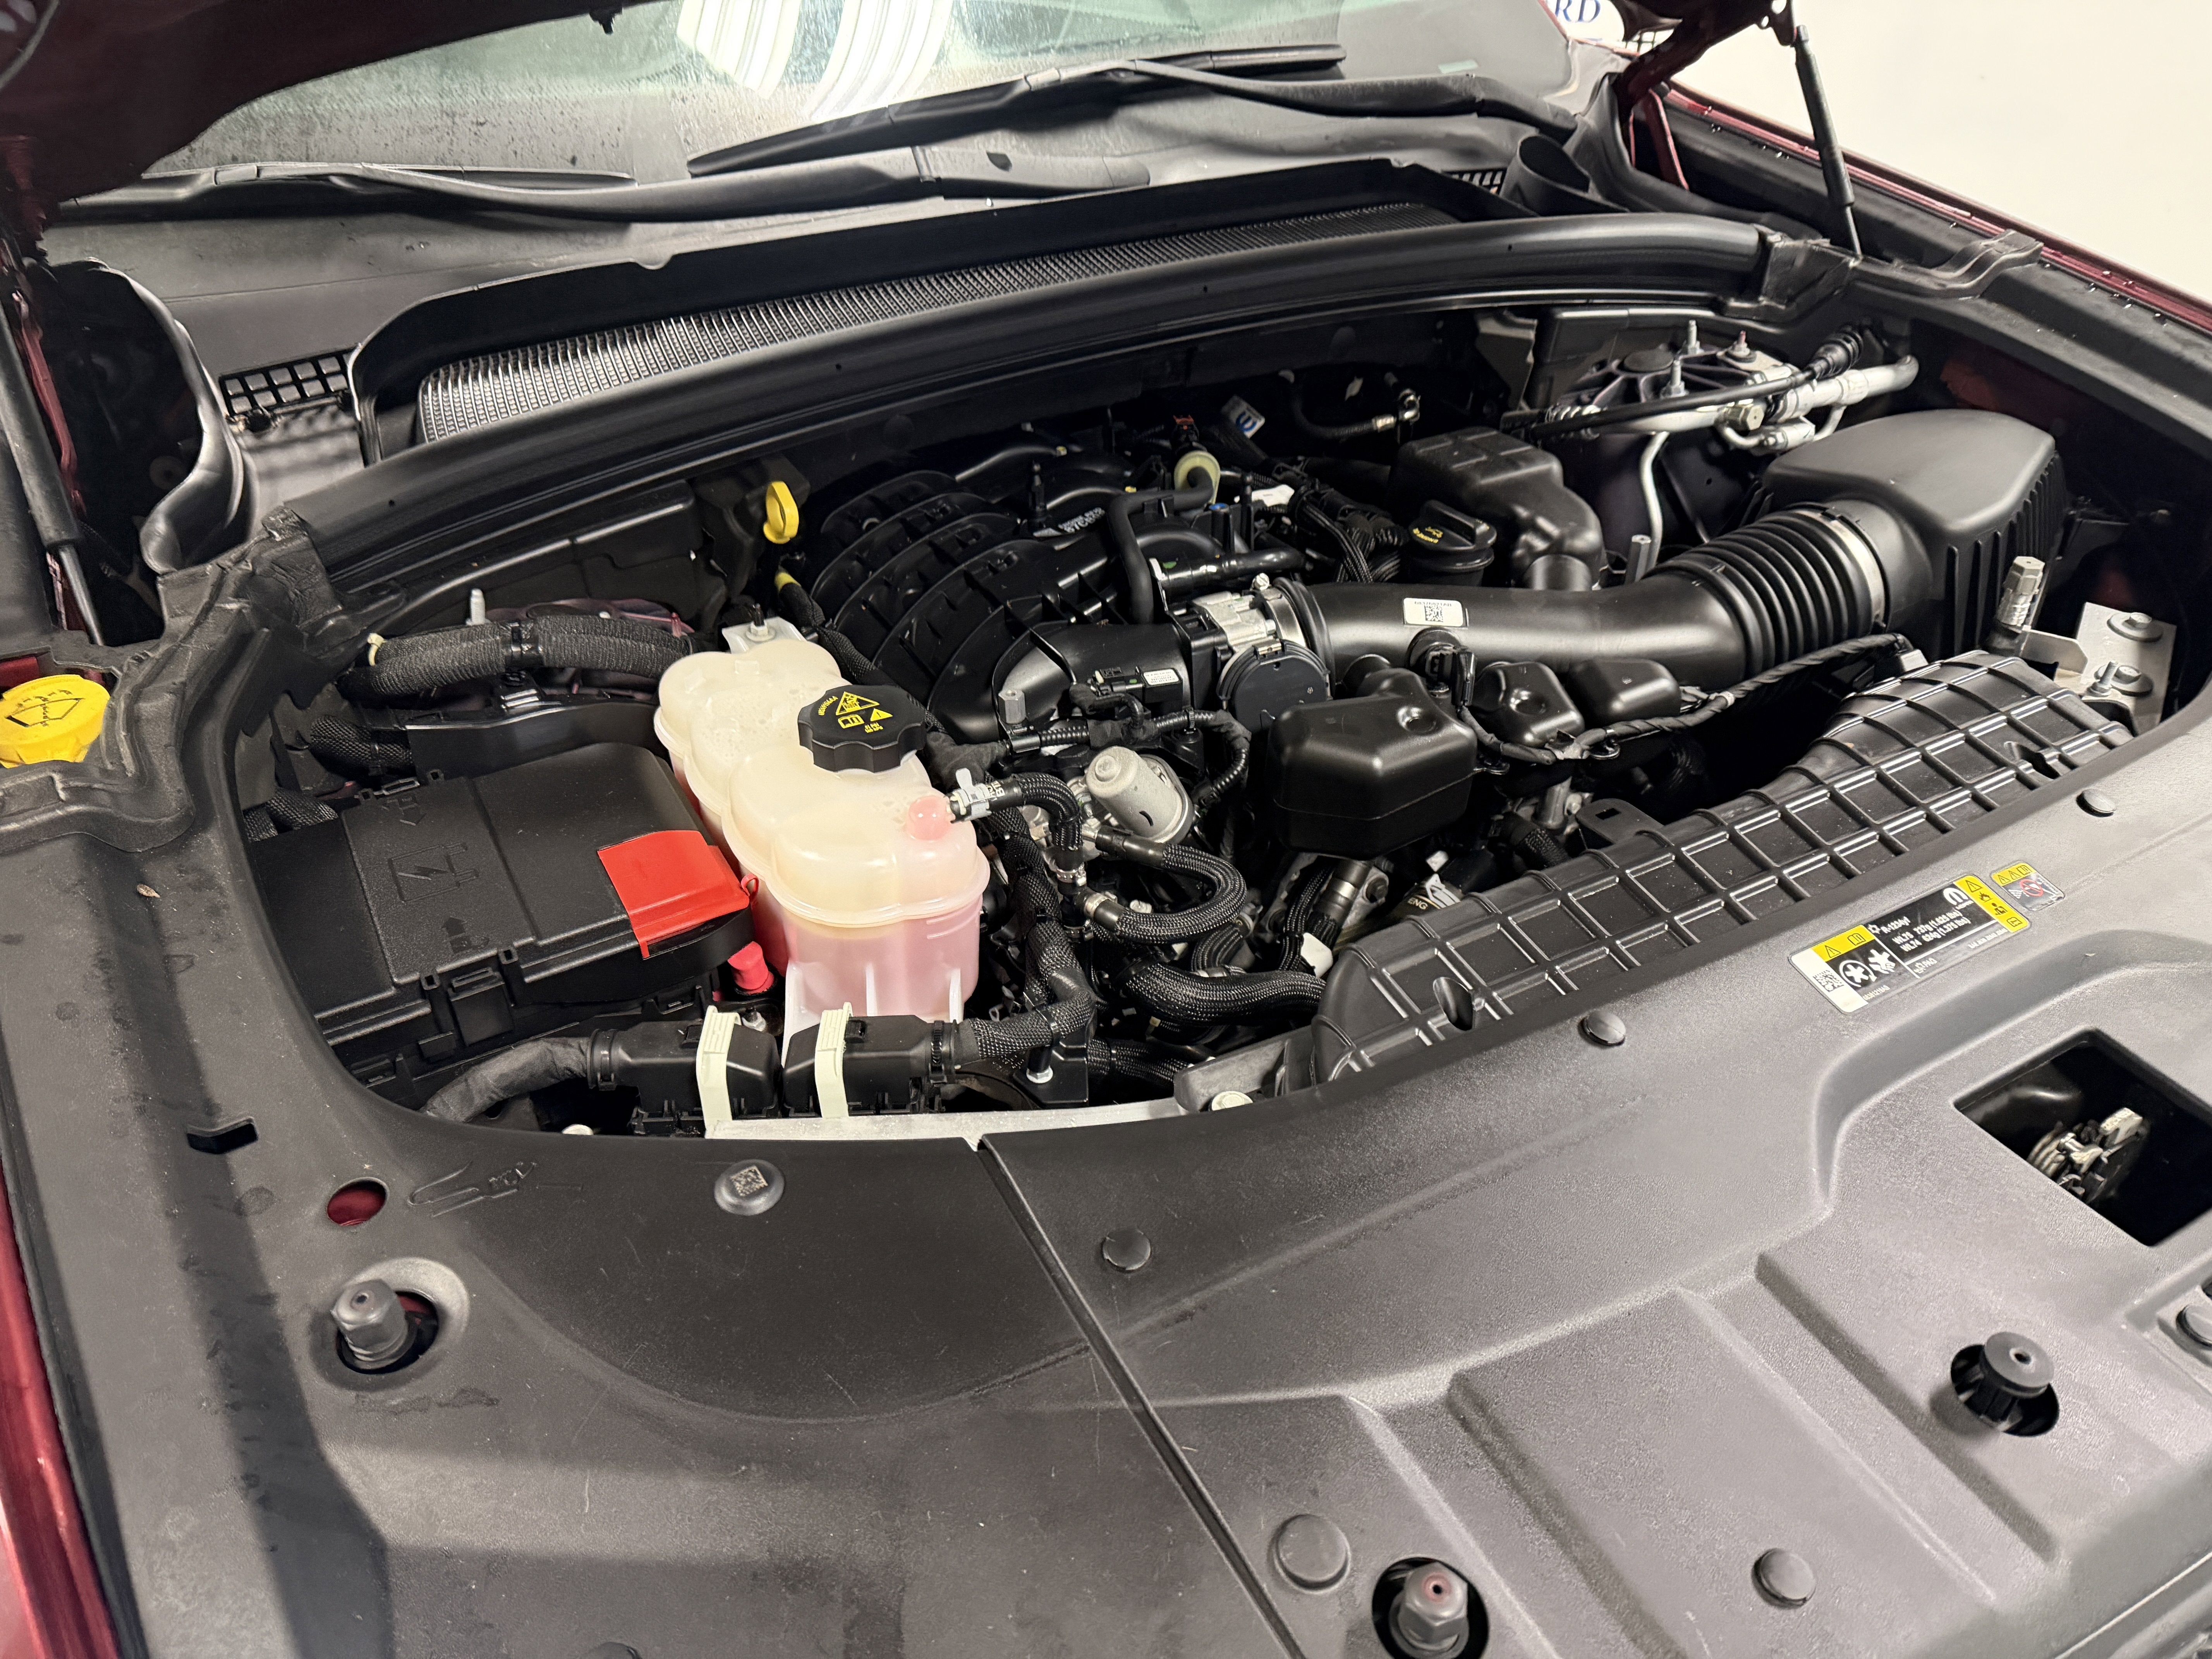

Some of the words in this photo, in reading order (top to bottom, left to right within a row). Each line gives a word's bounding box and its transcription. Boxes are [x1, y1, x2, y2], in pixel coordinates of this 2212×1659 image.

[1408, 897, 1428, 910] ENG
[1881, 916, 1911, 934] R-1234yf
[1892, 932, 1914, 945] WL75
[1913, 924, 1933, 934] 737g
[1930, 913, 1949, 928] (1.625
[1946, 909, 1963, 920] lbs)
[1900, 941, 1922, 952] WL74
[1922, 931, 1942, 942] 624g
[1955, 916, 1971, 927] lbs)
[1923, 958, 1938, 968] PAG
